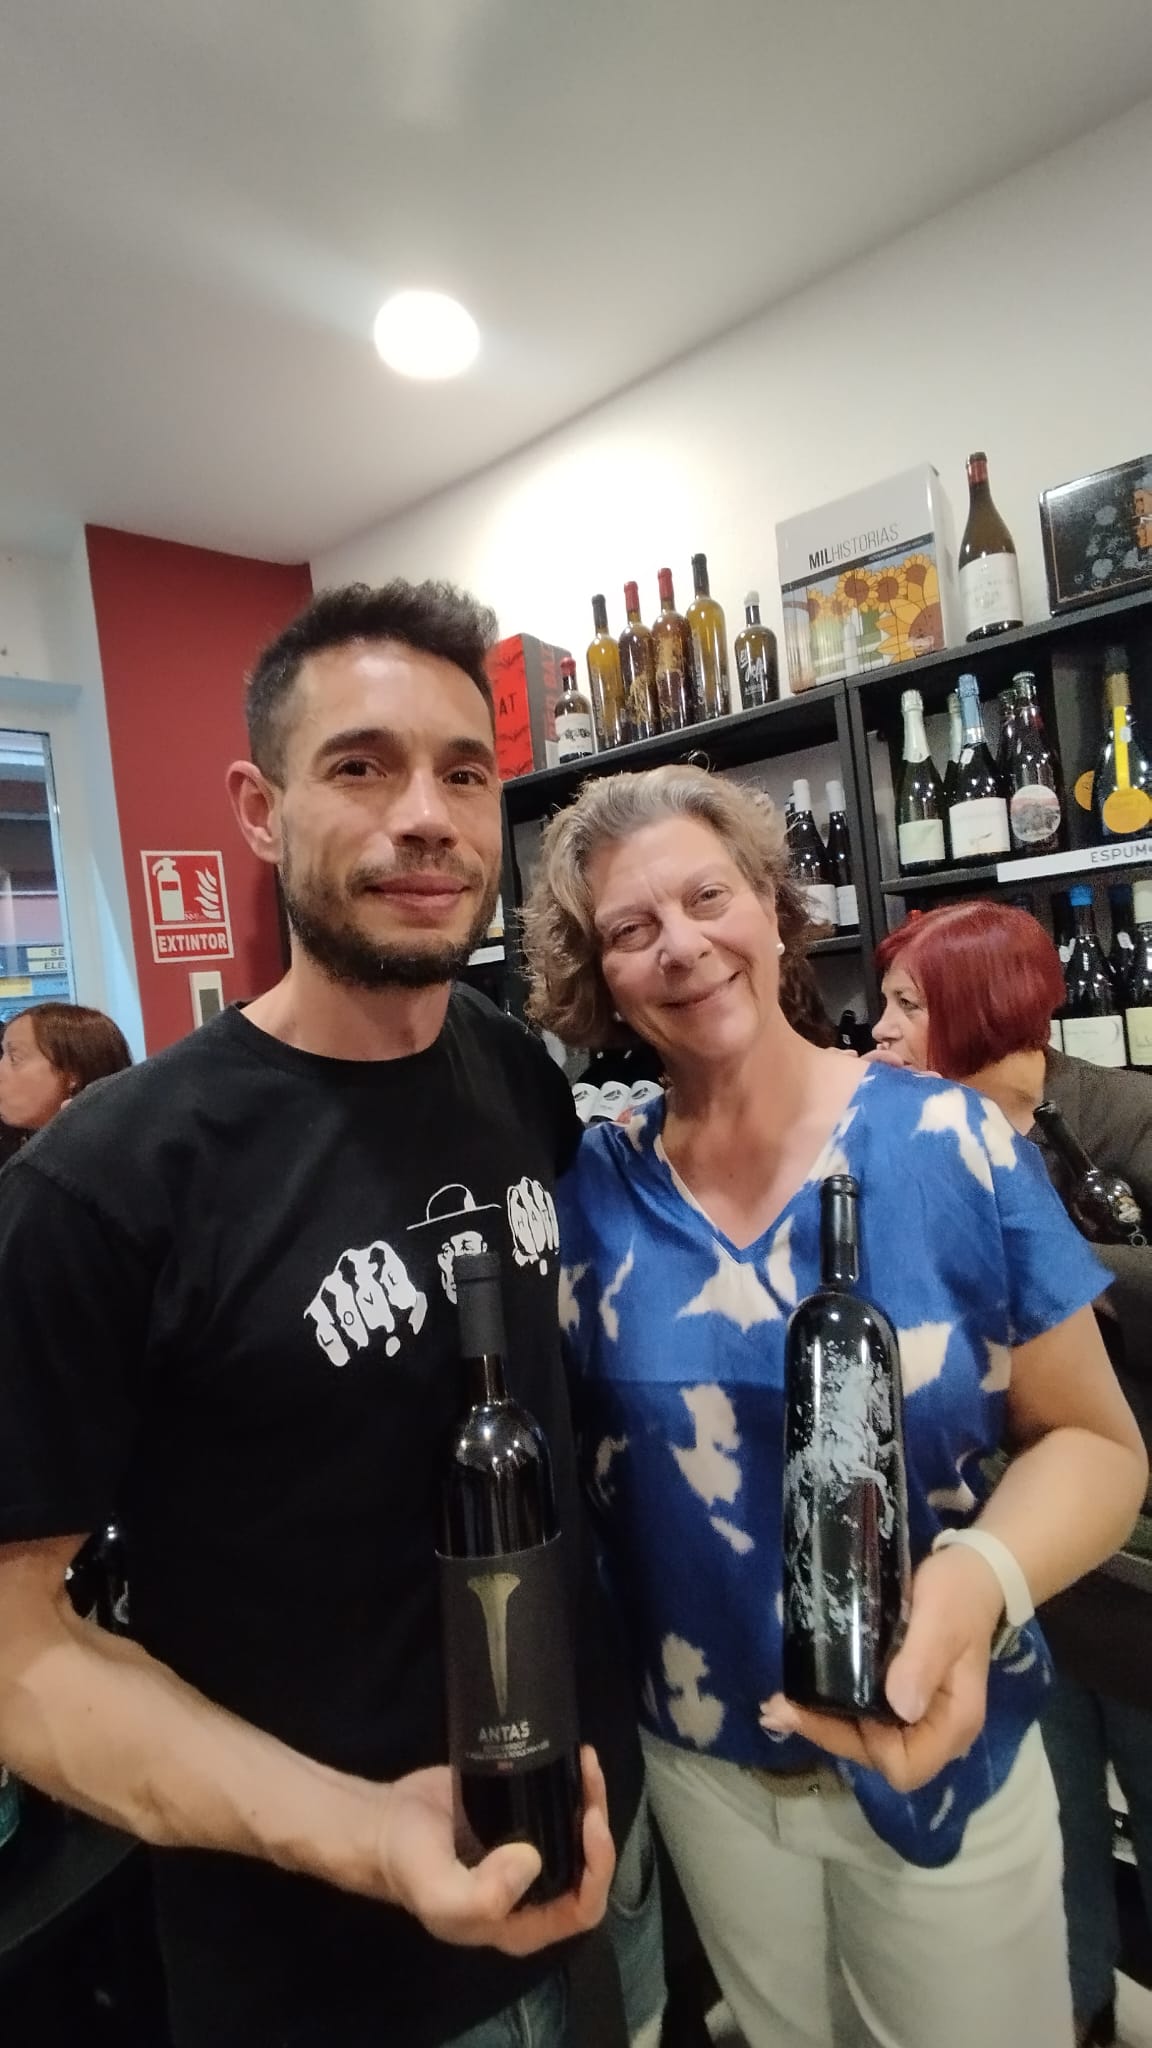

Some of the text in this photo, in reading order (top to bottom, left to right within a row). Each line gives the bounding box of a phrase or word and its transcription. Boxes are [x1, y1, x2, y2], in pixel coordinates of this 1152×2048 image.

[808, 523, 900, 571] MILHISTORIAS
[499, 692, 517, 718] AT
[157, 932, 227, 953] EXTINTOR
[44, 961, 67, 970] ELE
[478, 1721, 530, 1743] ANTAS
